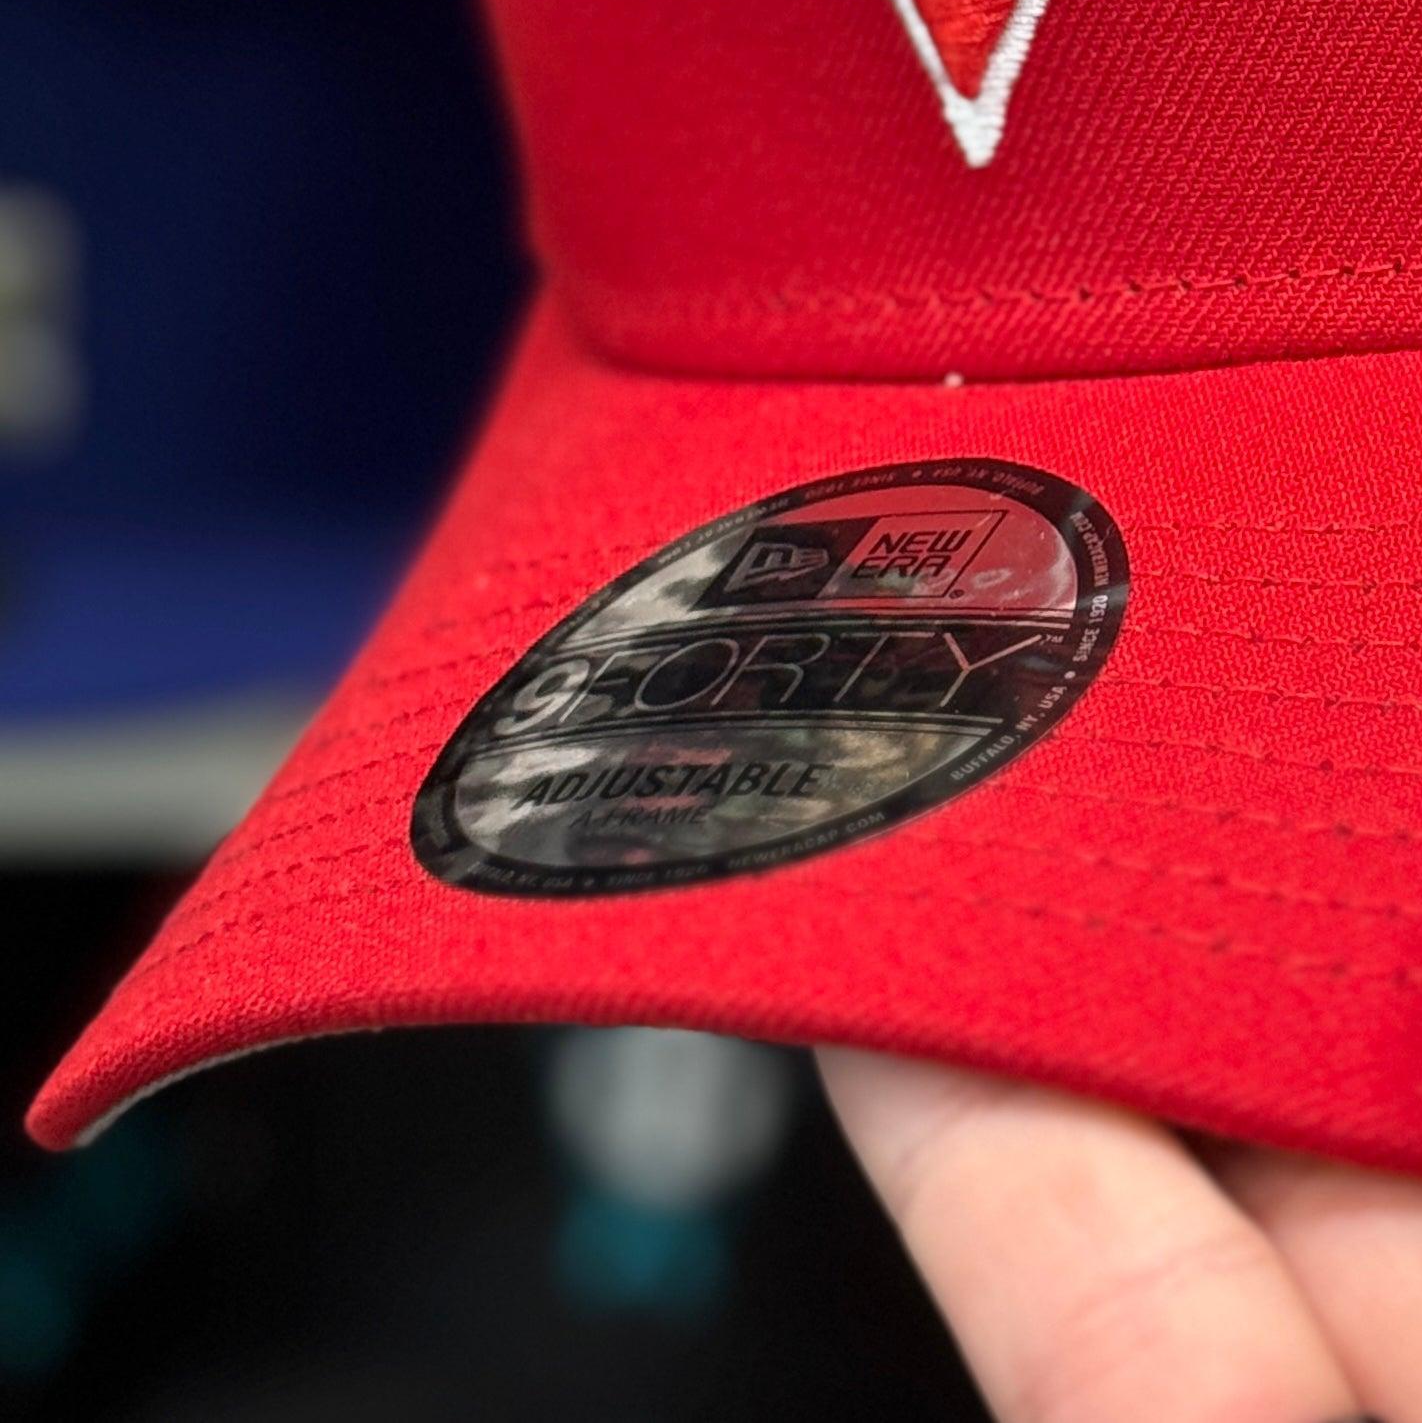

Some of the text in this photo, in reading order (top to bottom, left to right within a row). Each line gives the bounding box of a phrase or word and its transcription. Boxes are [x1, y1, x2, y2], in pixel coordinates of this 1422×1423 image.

[867, 529, 973, 556] NEW
[850, 554, 953, 579] ERA
[1072, 594, 1109, 663] SINCE 1920
[1037, 685, 1068, 710] USA
[510, 760, 834, 811] ADJUSTABLE
